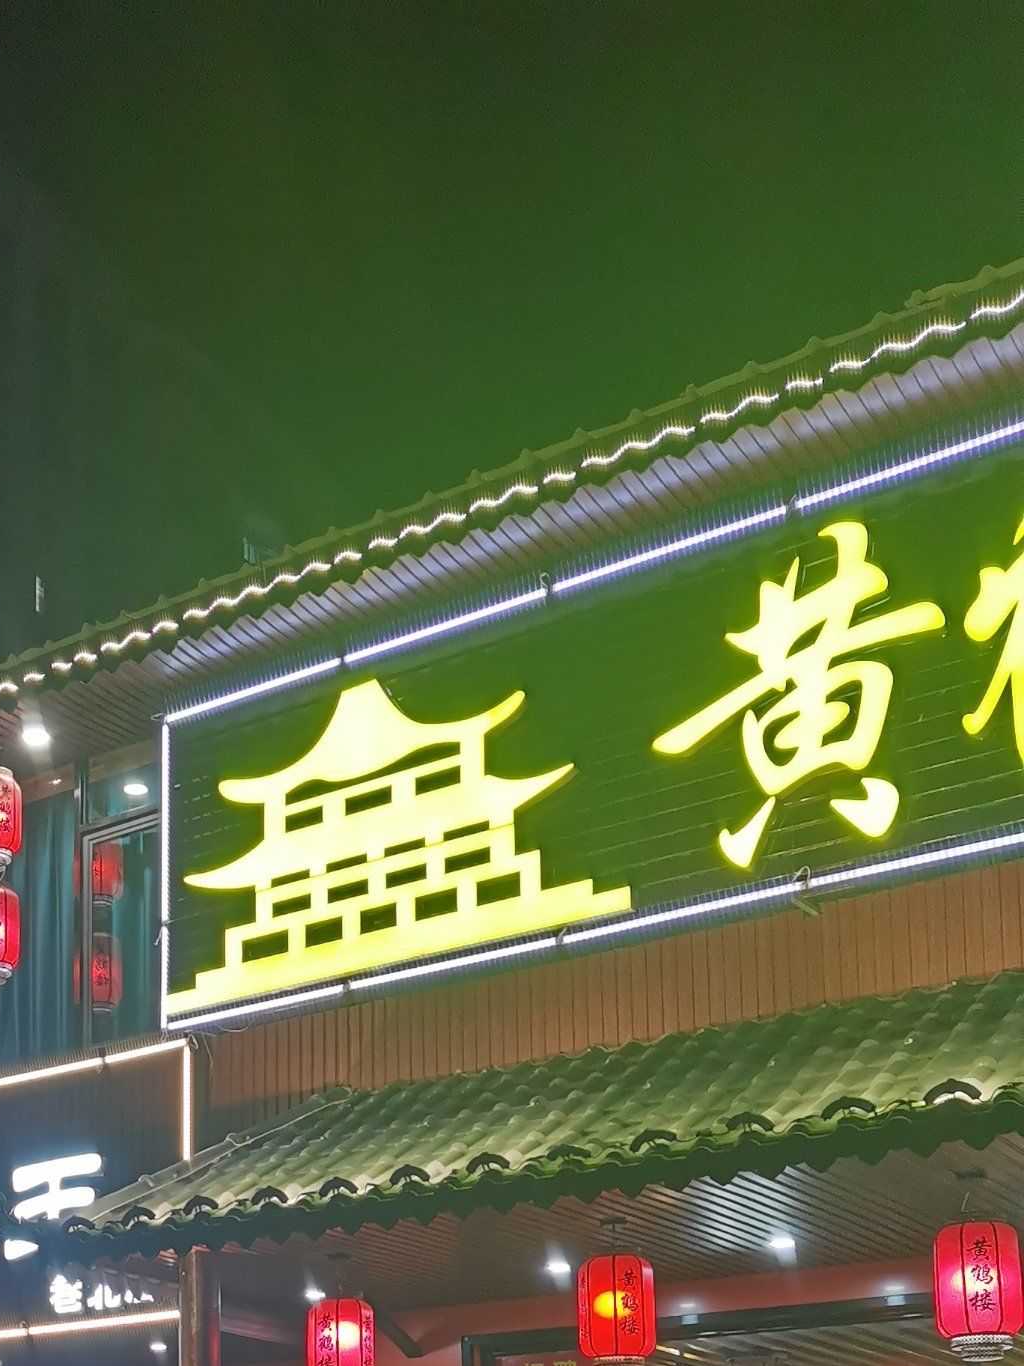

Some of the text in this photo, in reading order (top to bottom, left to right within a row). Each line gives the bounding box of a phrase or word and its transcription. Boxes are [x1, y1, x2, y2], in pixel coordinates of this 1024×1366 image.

[617, 1268, 642, 1336] 黄鹤楼
[966, 1235, 997, 1312] 黄鹤楼
